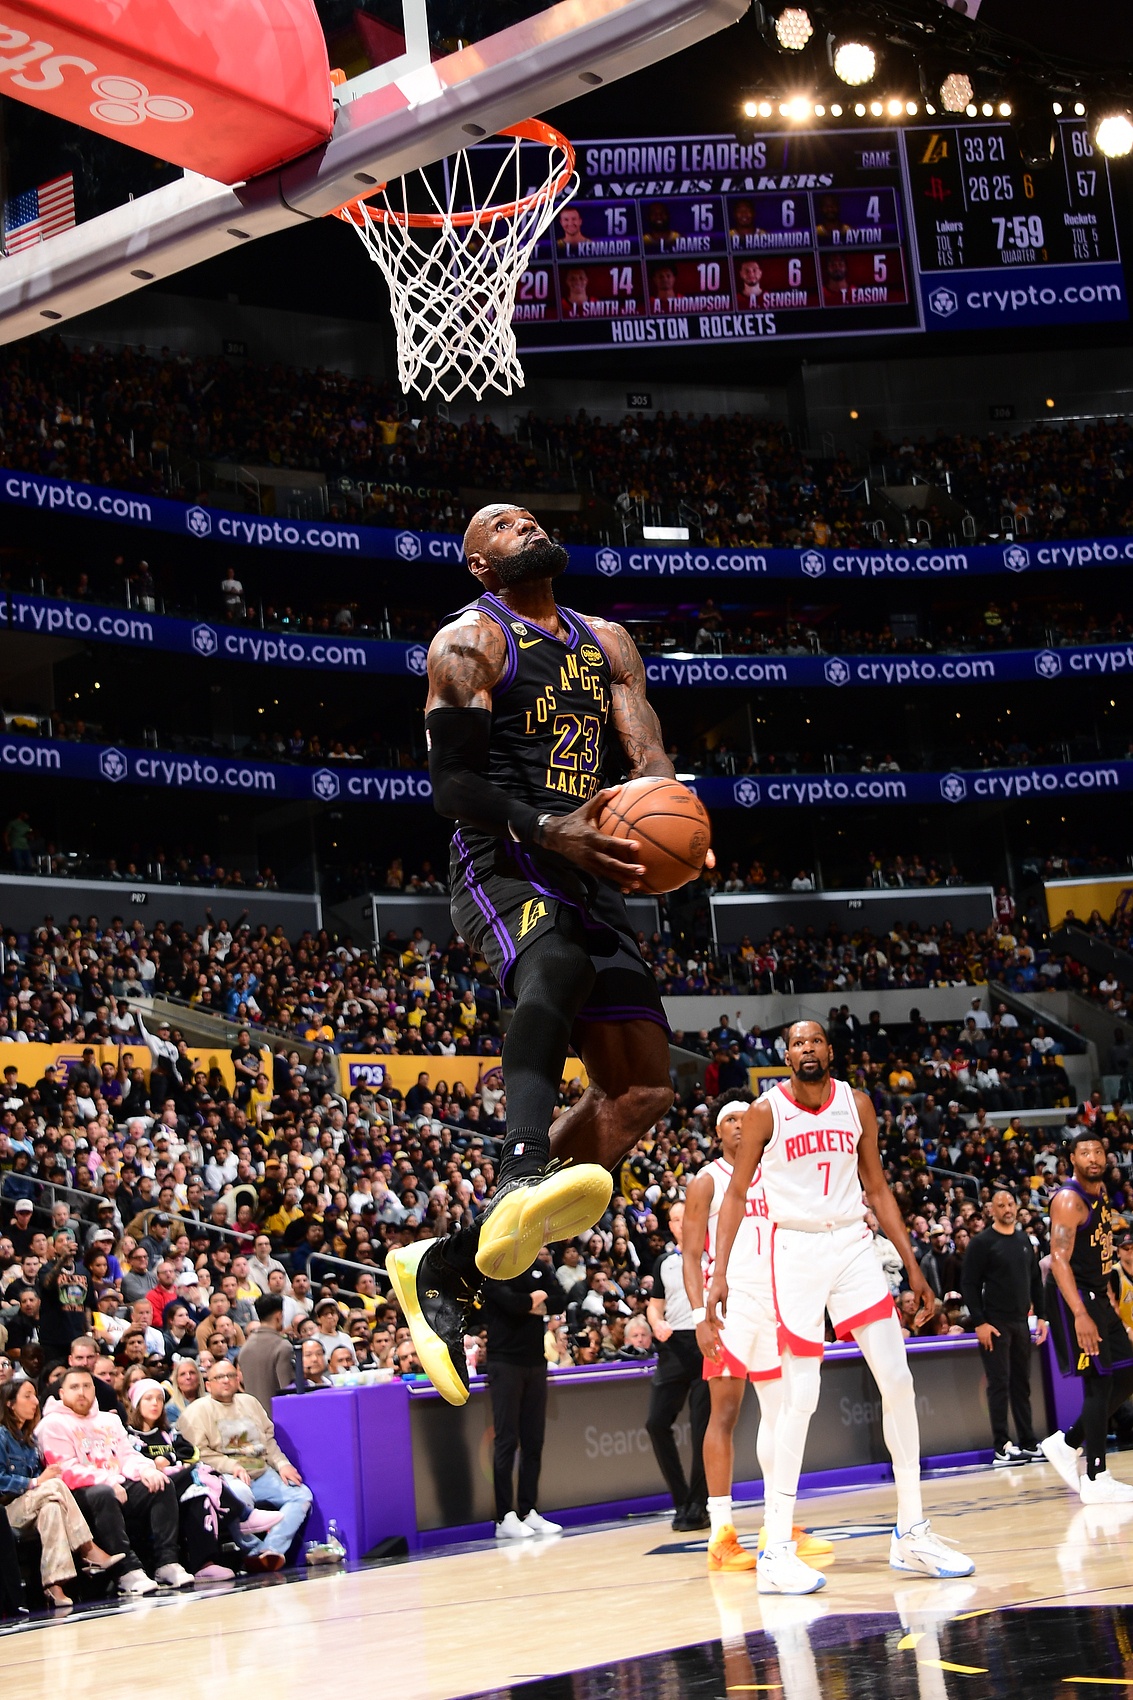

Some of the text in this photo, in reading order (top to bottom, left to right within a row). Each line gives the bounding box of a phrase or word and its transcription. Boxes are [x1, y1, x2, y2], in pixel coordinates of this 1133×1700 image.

[586, 141, 767, 176] SCORING LEADERS
[862, 151, 891, 167] GAME
[964, 137, 984, 163] 33
[988, 136, 1006, 161] 21
[586, 179, 713, 198] ANGELES
[720, 173, 834, 192] LAKERS
[968, 170, 1096, 202] 26 25 6 57
[604, 208, 627, 236] 15
[691, 203, 714, 232] 15
[781, 200, 795, 228] 6
[866, 196, 881, 223] 4
[1063, 212, 1097, 226] Rockets
[745, 231, 811, 247] HACHIMURA
[845, 228, 882, 243] AYTON
[936, 220, 964, 232] Lakers
[991, 215, 1045, 250] 7:59
[578, 239, 632, 257] KENNARD
[672, 236, 711, 253] JAMES
[1001, 248, 1036, 263] QUARTER
[610, 267, 634, 295] 14
[697, 262, 720, 291] 10
[788, 258, 802, 287] 6
[873, 254, 887, 283] 5
[520, 271, 549, 300] 20
[851, 287, 888, 303] EASON
[966, 283, 1122, 312] crypto.com
[582, 301, 619, 317] SMITH
[667, 294, 730, 312] THOMPSON
[611, 313, 776, 342] HOUSTON ROCKETS
[631, 395, 648, 406] 305
[6, 477, 152, 521] crypto.com
[218, 517, 360, 550] crypto.com
[629, 551, 767, 575] crypto.com
[832, 552, 968, 576] crypto.com
[0, 601, 153, 641] crypto.com
[225, 633, 367, 666] crypto.com
[646, 660, 787, 685] crypto.com
[857, 660, 995, 684] crypto.com
[525, 686, 556, 735] LOS
[550, 713, 601, 774] 23
[135, 756, 276, 790] crypto.com
[974, 767, 1119, 796] crypto.com
[768, 779, 907, 804] crypto.com
[785, 1129, 854, 1163] ROCKETS
[817, 1162, 831, 1196] 7
[756, 1226, 761, 1255] 1
